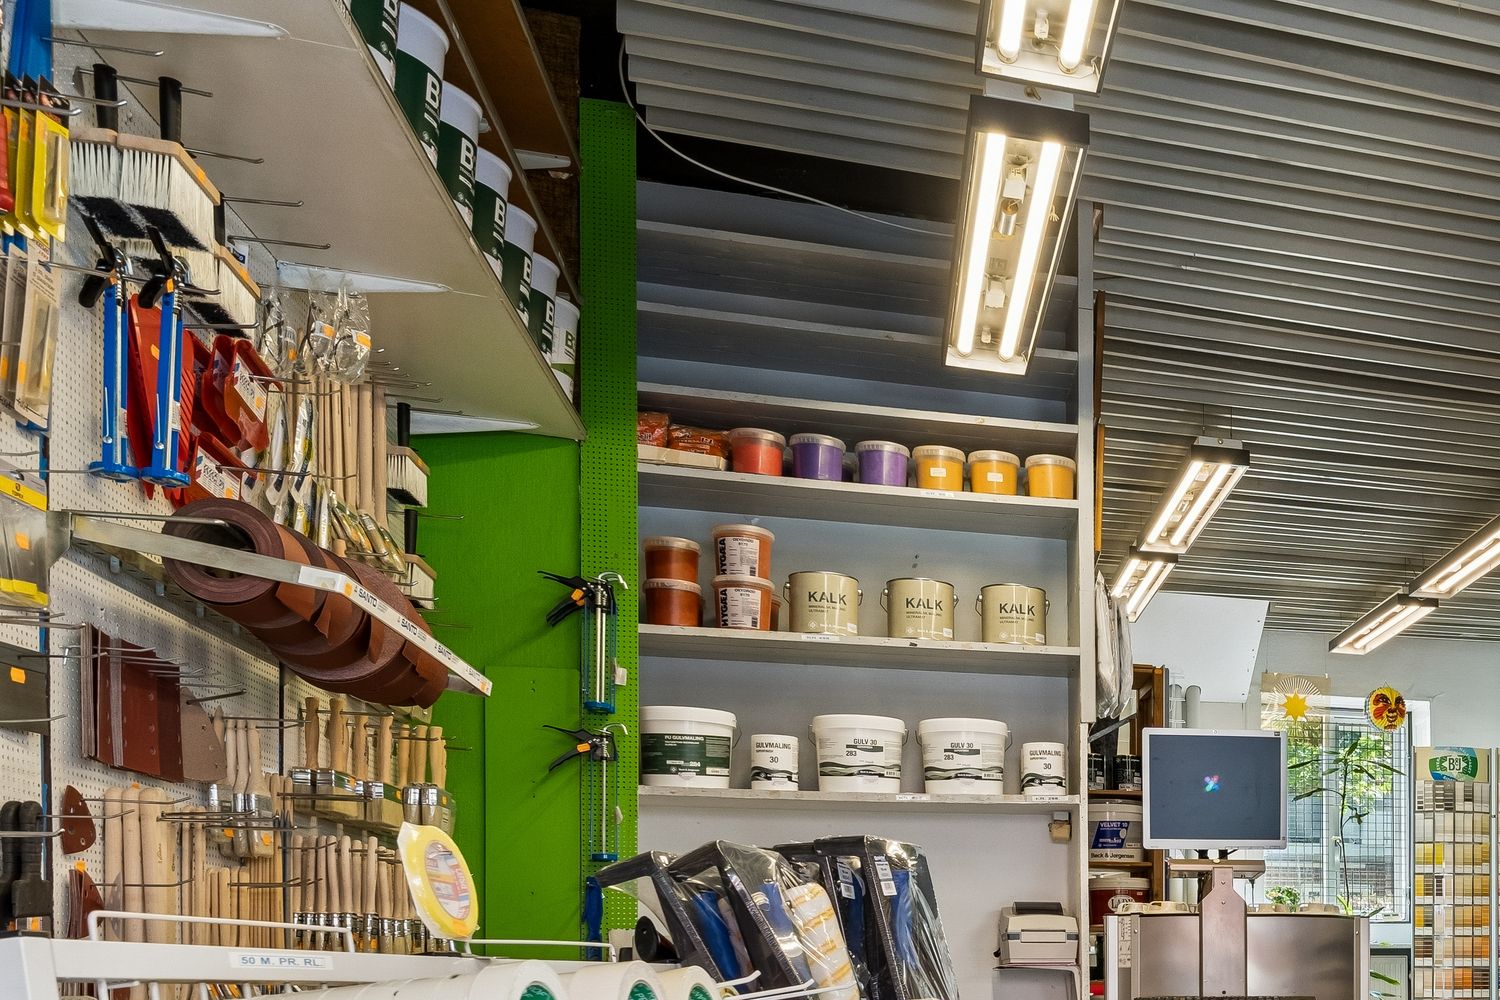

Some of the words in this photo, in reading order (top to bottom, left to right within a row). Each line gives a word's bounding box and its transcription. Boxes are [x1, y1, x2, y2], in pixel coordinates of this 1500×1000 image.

[359, 588, 378, 608] SANTO
[808, 590, 847, 606] KALK
[720, 587, 729, 628] HYGÆA
[905, 597, 943, 612] KALK
[999, 602, 1036, 617] KALK
[755, 742, 792, 750] GULVMALING
[1029, 749, 1062, 757] GULVMALING
[769, 756, 779, 764] 30
[1043, 762, 1052, 770] 30
[241, 956, 256, 965] 50
[279, 957, 297, 966] PR.
